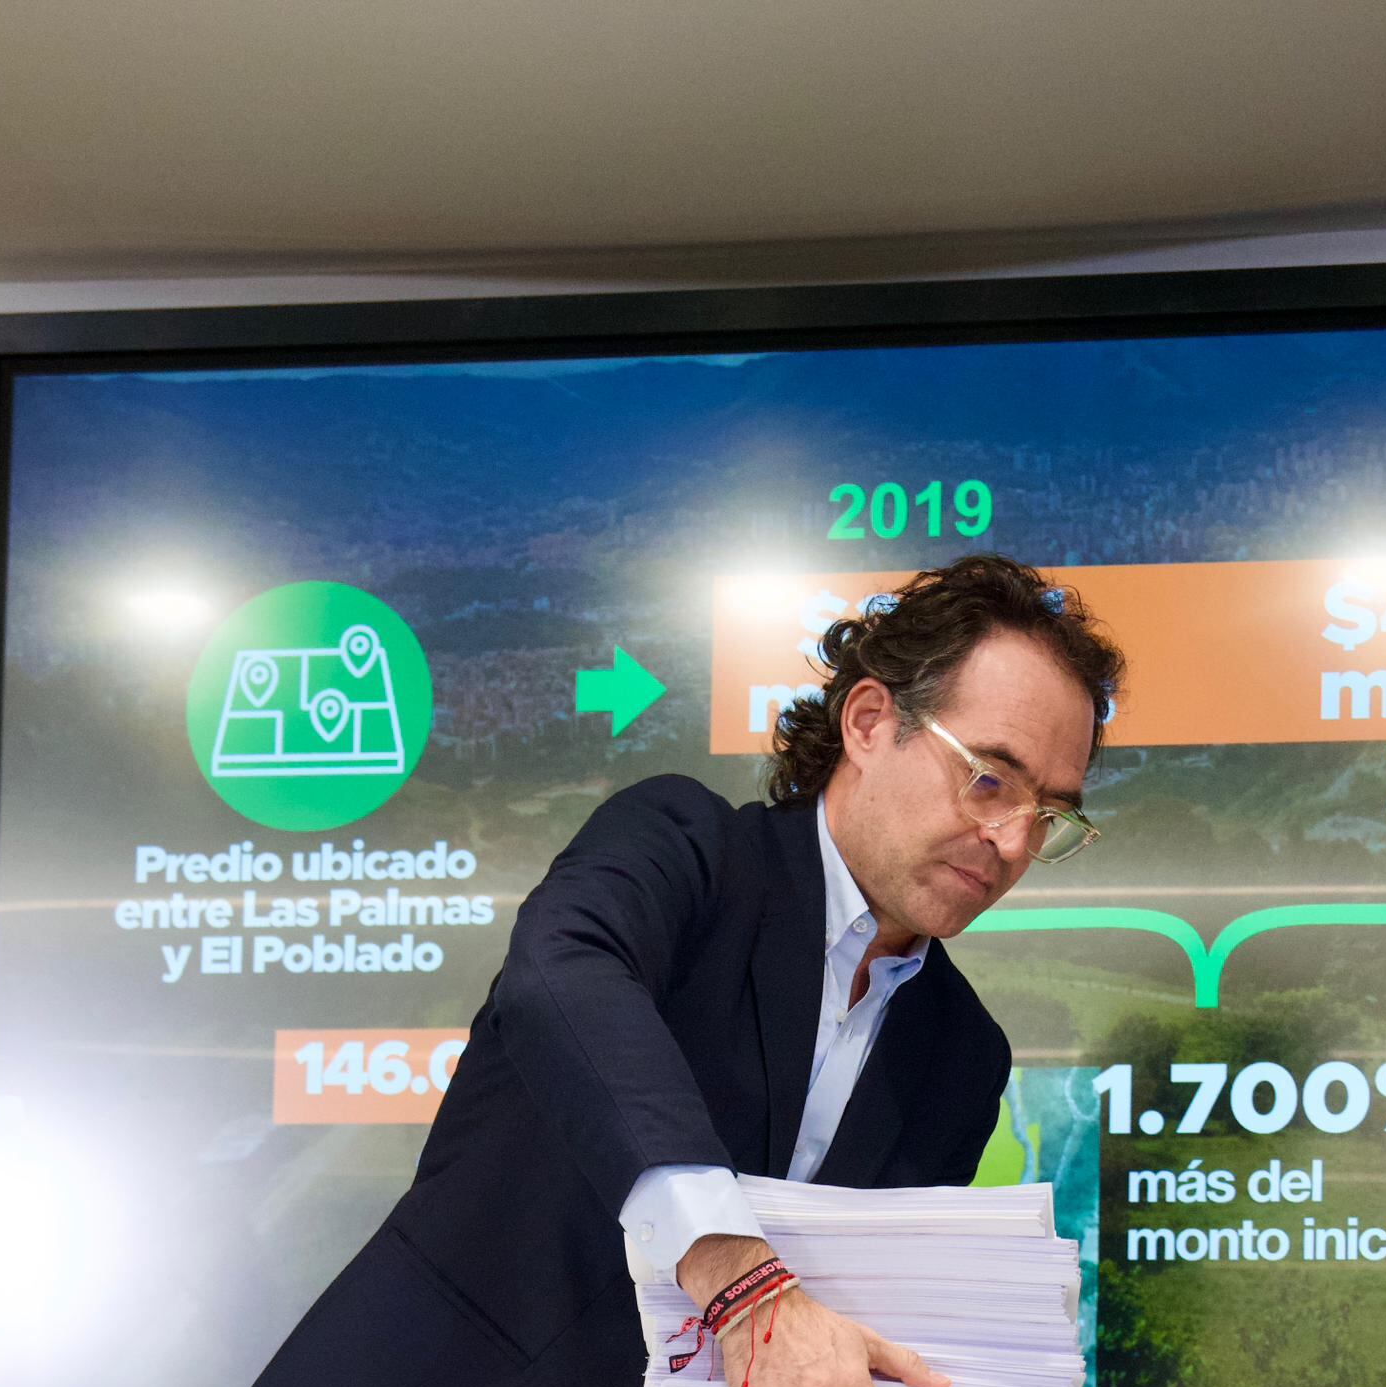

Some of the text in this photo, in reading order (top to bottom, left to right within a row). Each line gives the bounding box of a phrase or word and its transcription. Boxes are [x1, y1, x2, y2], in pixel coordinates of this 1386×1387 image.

[826, 479, 993, 541] 2019
[135, 839, 477, 884] Predio ubicado
[114, 888, 495, 930] entre Las Palmas
[161, 934, 444, 983] y El Poblado
[1128, 1159, 1323, 1203] más del
[1127, 1219, 1290, 1261] monto
